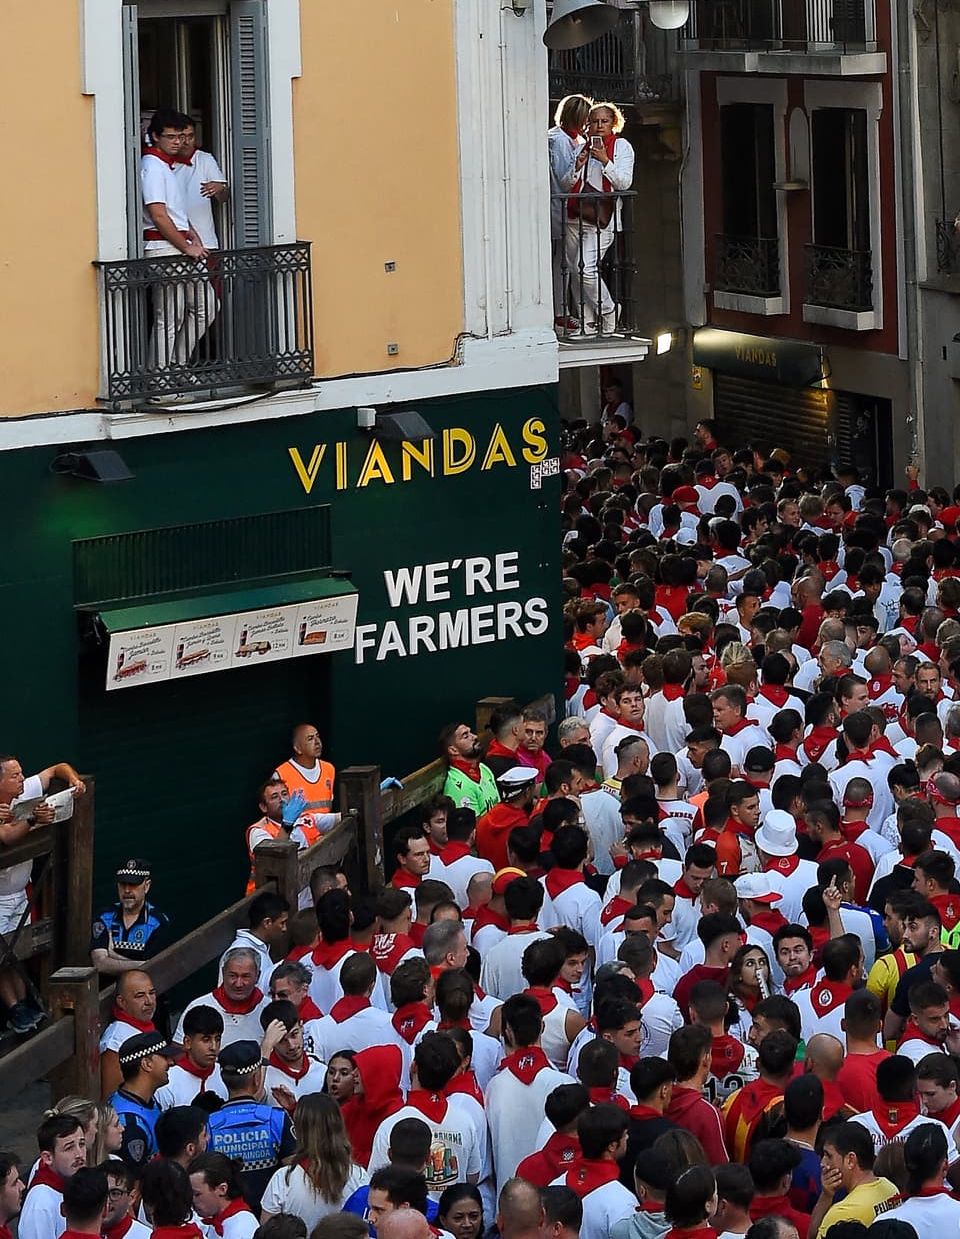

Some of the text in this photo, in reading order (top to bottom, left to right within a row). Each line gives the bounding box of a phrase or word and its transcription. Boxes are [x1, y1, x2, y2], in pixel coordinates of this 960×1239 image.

[288, 417, 549, 494] VIANDAS
[355, 597, 549, 664] FARMERS
[720, 862, 728, 873] 7
[214, 1129, 269, 1145] POLICIA
[214, 1141, 271, 1153] MUNICIPAL
